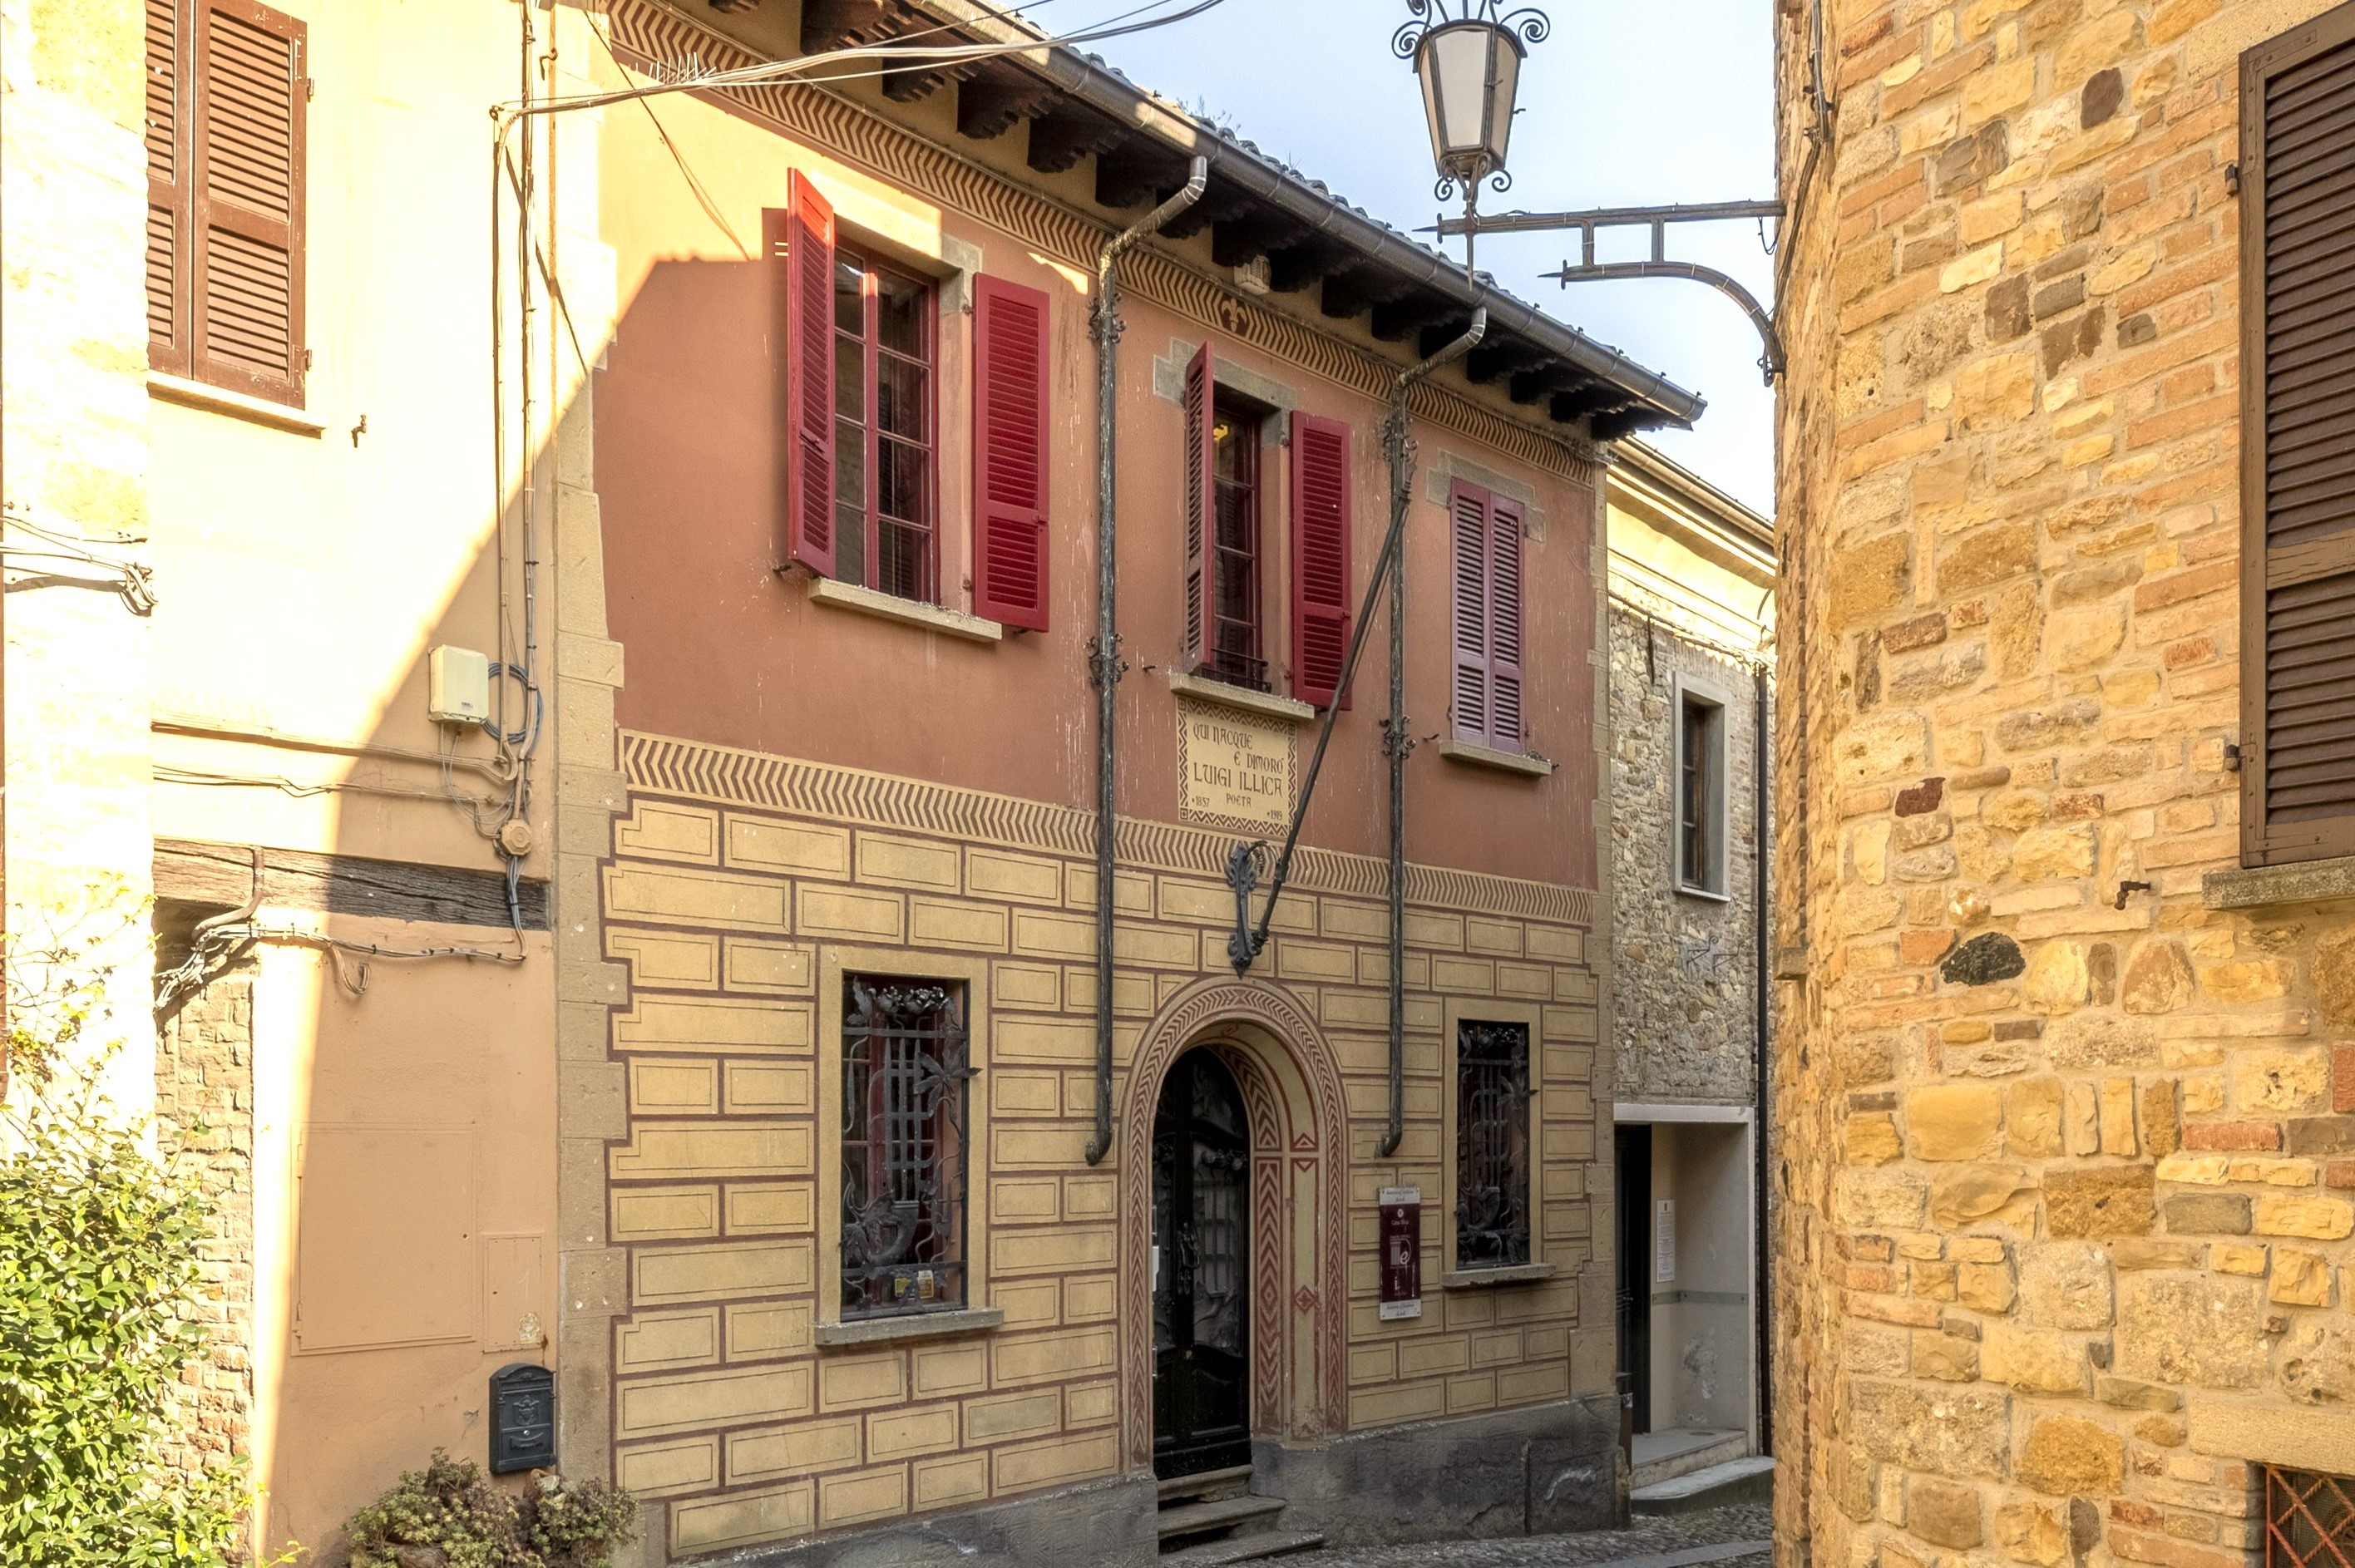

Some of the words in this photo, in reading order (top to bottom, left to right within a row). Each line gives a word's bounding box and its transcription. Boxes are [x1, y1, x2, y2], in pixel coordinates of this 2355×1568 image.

[1192, 722, 1209, 741] QUI
[1212, 725, 1253, 750] NACQUE
[1234, 751, 1241, 766] E
[1193, 762, 1232, 788] LUIGI
[1239, 771, 1282, 798] ILLICA
[1226, 792, 1252, 808] POETA
